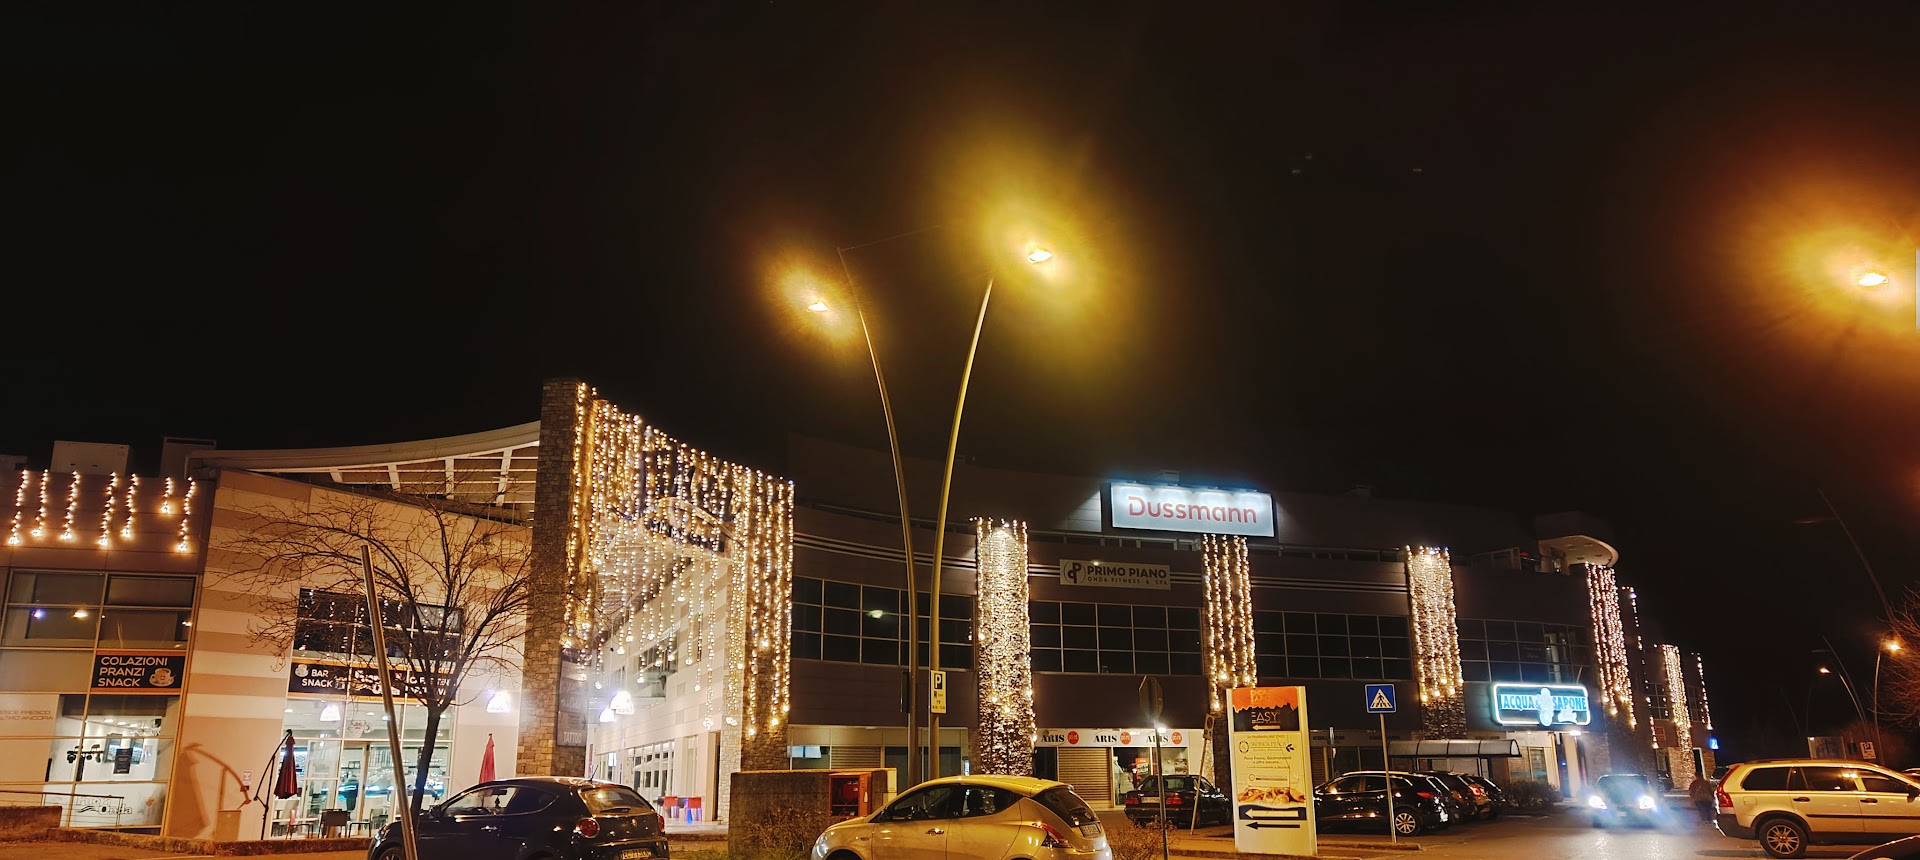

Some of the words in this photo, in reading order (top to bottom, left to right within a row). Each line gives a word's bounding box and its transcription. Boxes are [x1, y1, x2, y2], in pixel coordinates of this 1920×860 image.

[1128, 495, 1257, 524] Dussmann
[1087, 565, 1126, 577] PRIMO
[1129, 567, 1167, 579] PIANO
[101, 656, 168, 666] COLAZIONI
[99, 667, 146, 677] PRANZI
[311, 669, 329, 678] BAR
[97, 678, 141, 687] SNACK
[301, 678, 334, 688] SNACK
[934, 674, 942, 689] P
[1503, 695, 1535, 710] ACQUA
[1552, 696, 1587, 710] SAPONE
[1251, 711, 1278, 722] EASY
[563, 731, 582, 744] TATTOO
[1041, 734, 1065, 743] ARIS
[1093, 734, 1118, 743] ARIS
[98, 803, 133, 815] Onda
